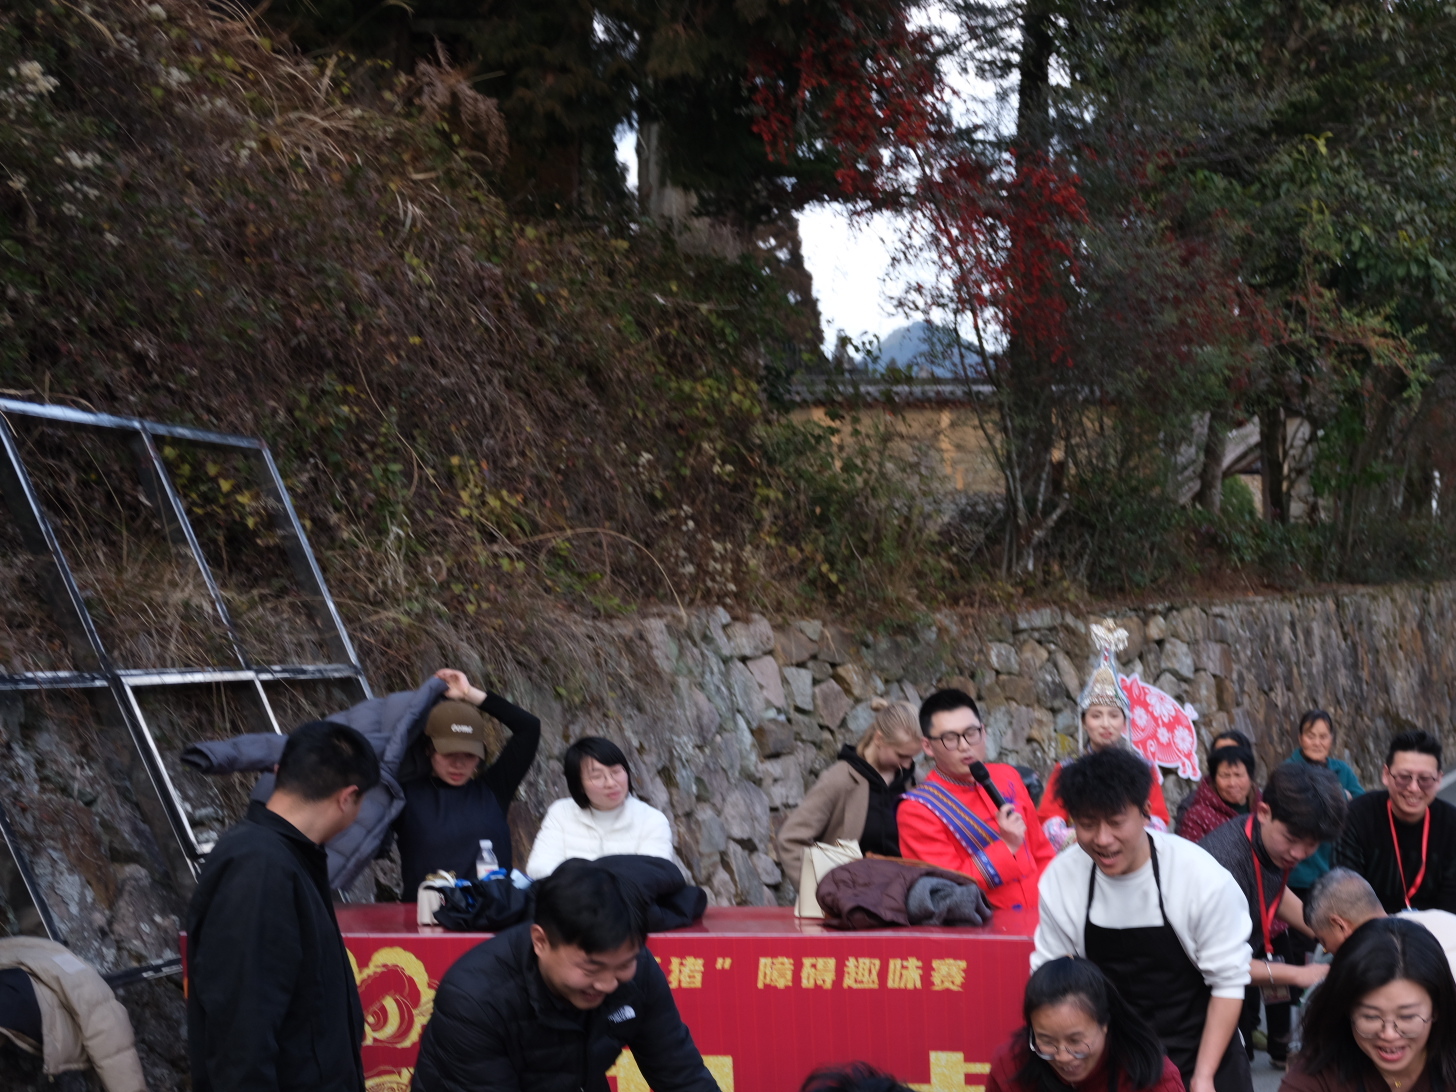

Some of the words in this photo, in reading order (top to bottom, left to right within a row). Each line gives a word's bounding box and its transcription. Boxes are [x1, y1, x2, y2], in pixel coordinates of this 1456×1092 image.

[653, 956, 967, 991] 猪”障碍趣味赛
